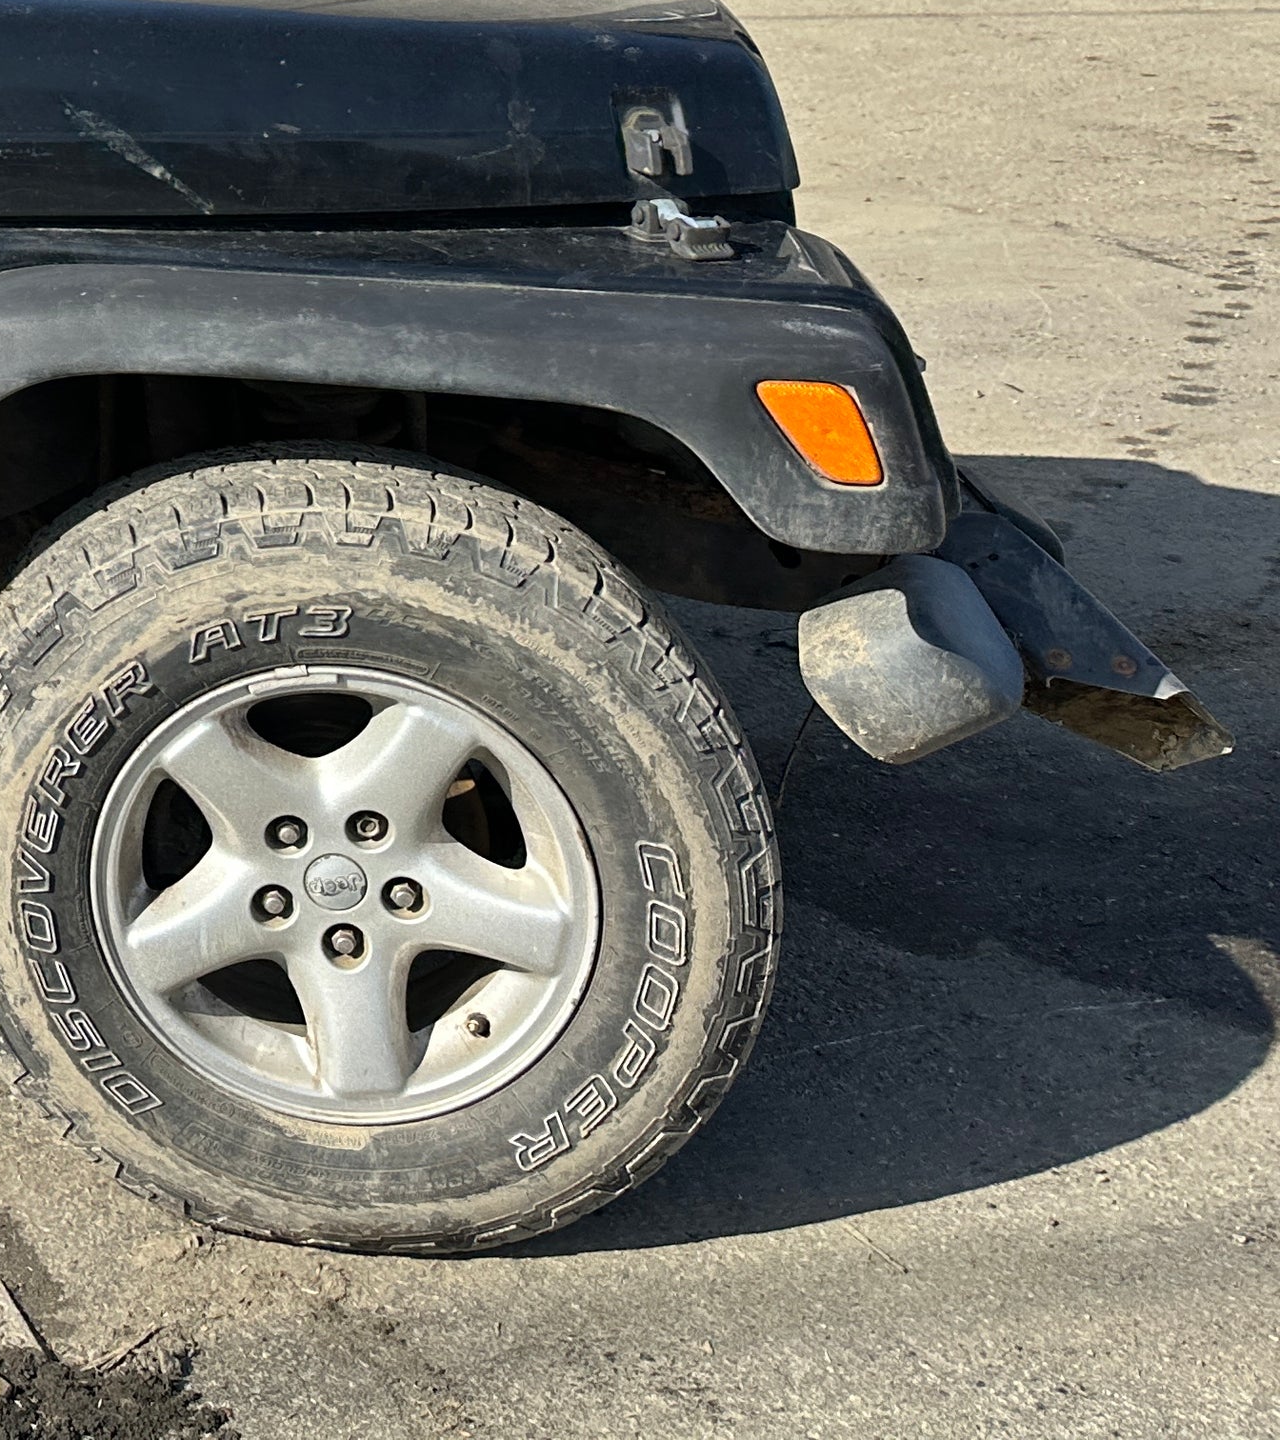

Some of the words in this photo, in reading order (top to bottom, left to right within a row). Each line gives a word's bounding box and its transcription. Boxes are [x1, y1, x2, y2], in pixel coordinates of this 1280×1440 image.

[15, 659, 165, 1117] DISCOVERER
[188, 604, 355, 664] AT3
[308, 872, 363, 898] Jeep
[508, 840, 689, 1173] COOPER
